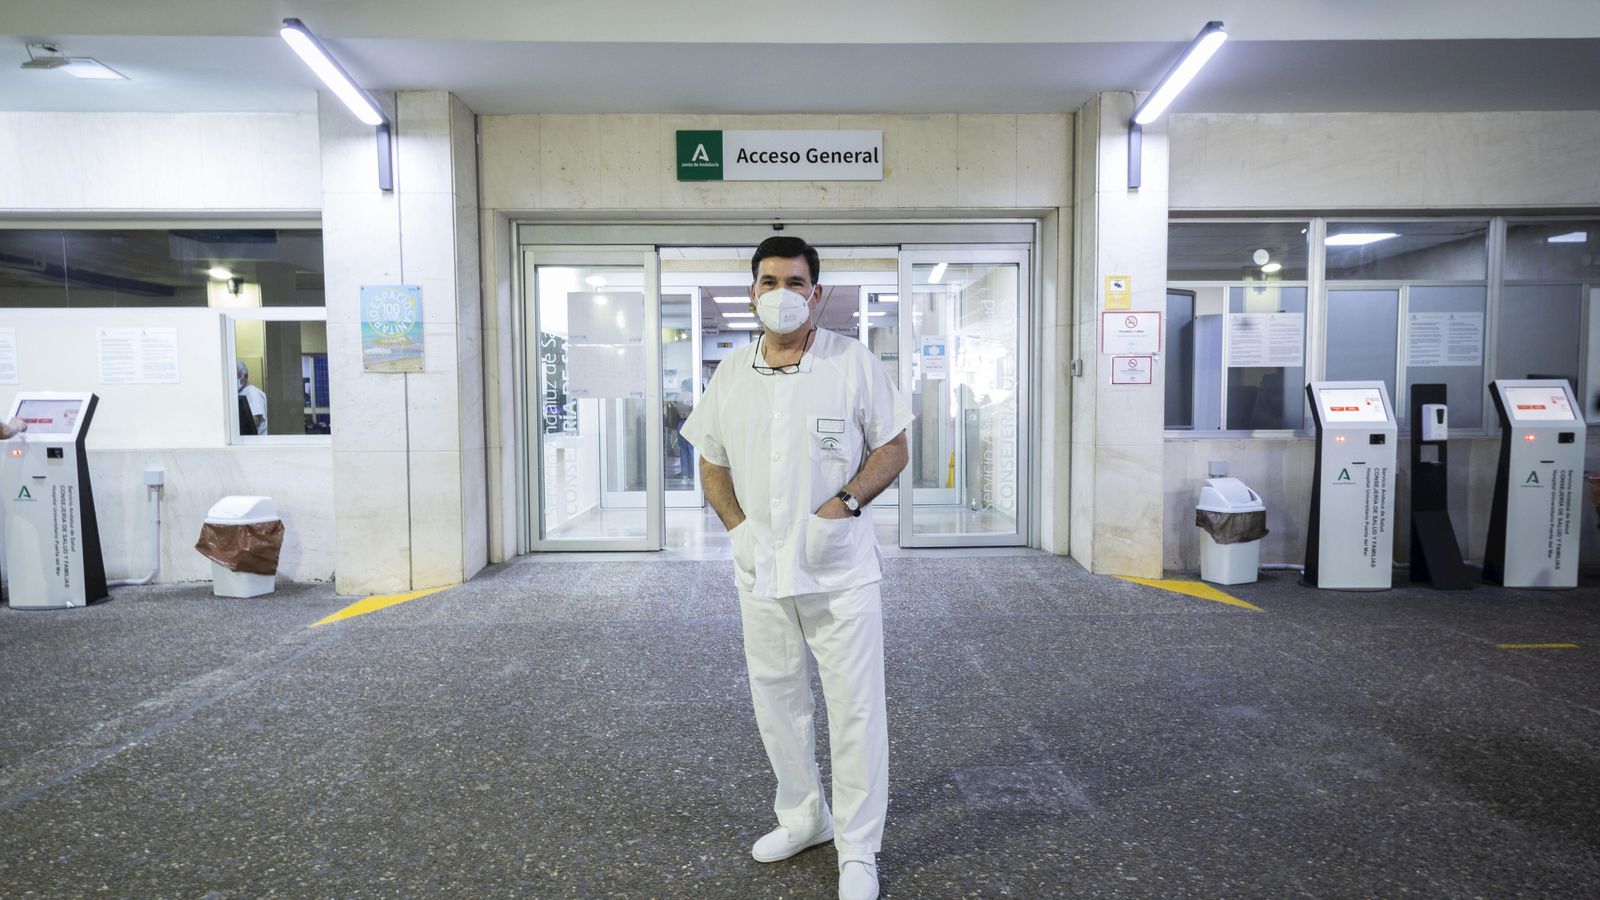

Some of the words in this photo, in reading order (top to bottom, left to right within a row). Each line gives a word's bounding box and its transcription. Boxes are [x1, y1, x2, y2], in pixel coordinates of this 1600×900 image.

[736, 148, 801, 164] Acceso
[806, 147, 880, 164] General
[980, 450, 994, 512] Servicio
[1372, 505, 1379, 513] DE
[61, 524, 68, 532] DE
